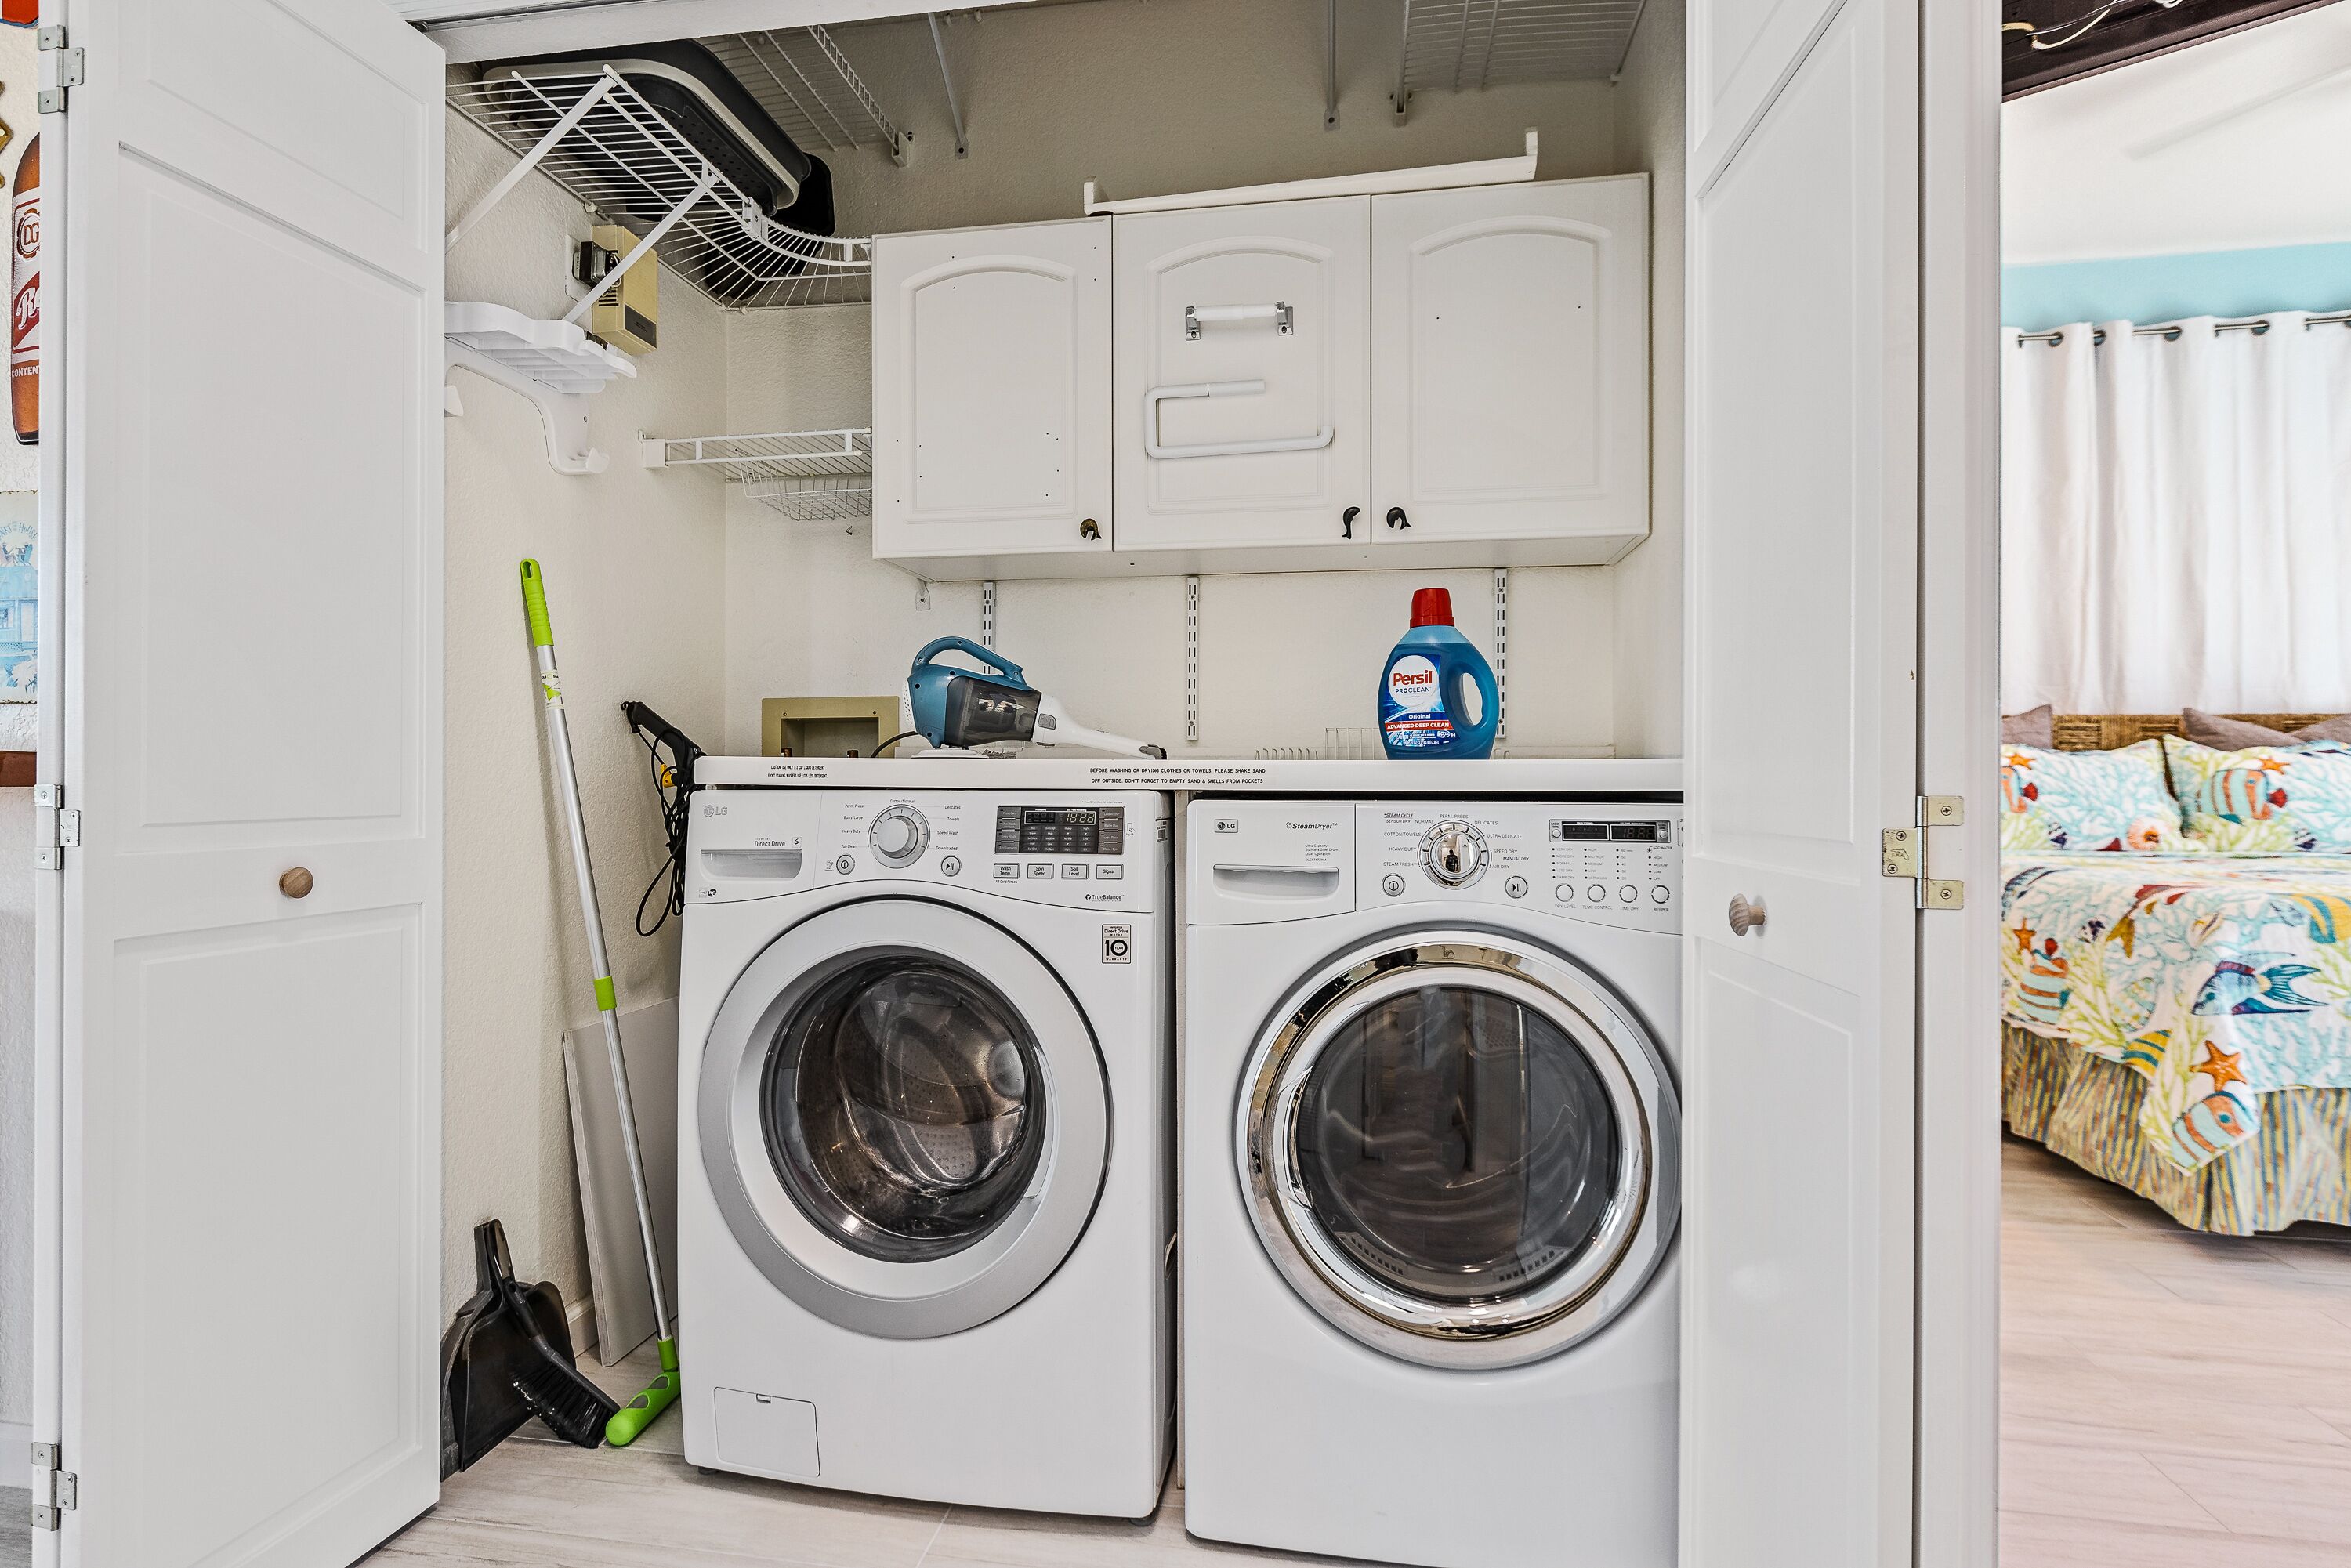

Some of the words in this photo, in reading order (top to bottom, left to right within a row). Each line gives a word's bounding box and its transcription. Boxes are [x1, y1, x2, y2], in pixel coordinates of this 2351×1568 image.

[12, 365, 39, 378] CONTEN
[1393, 669, 1433, 686] Persil
[715, 806, 728, 815] LG
[1105, 939, 1128, 956] 10
